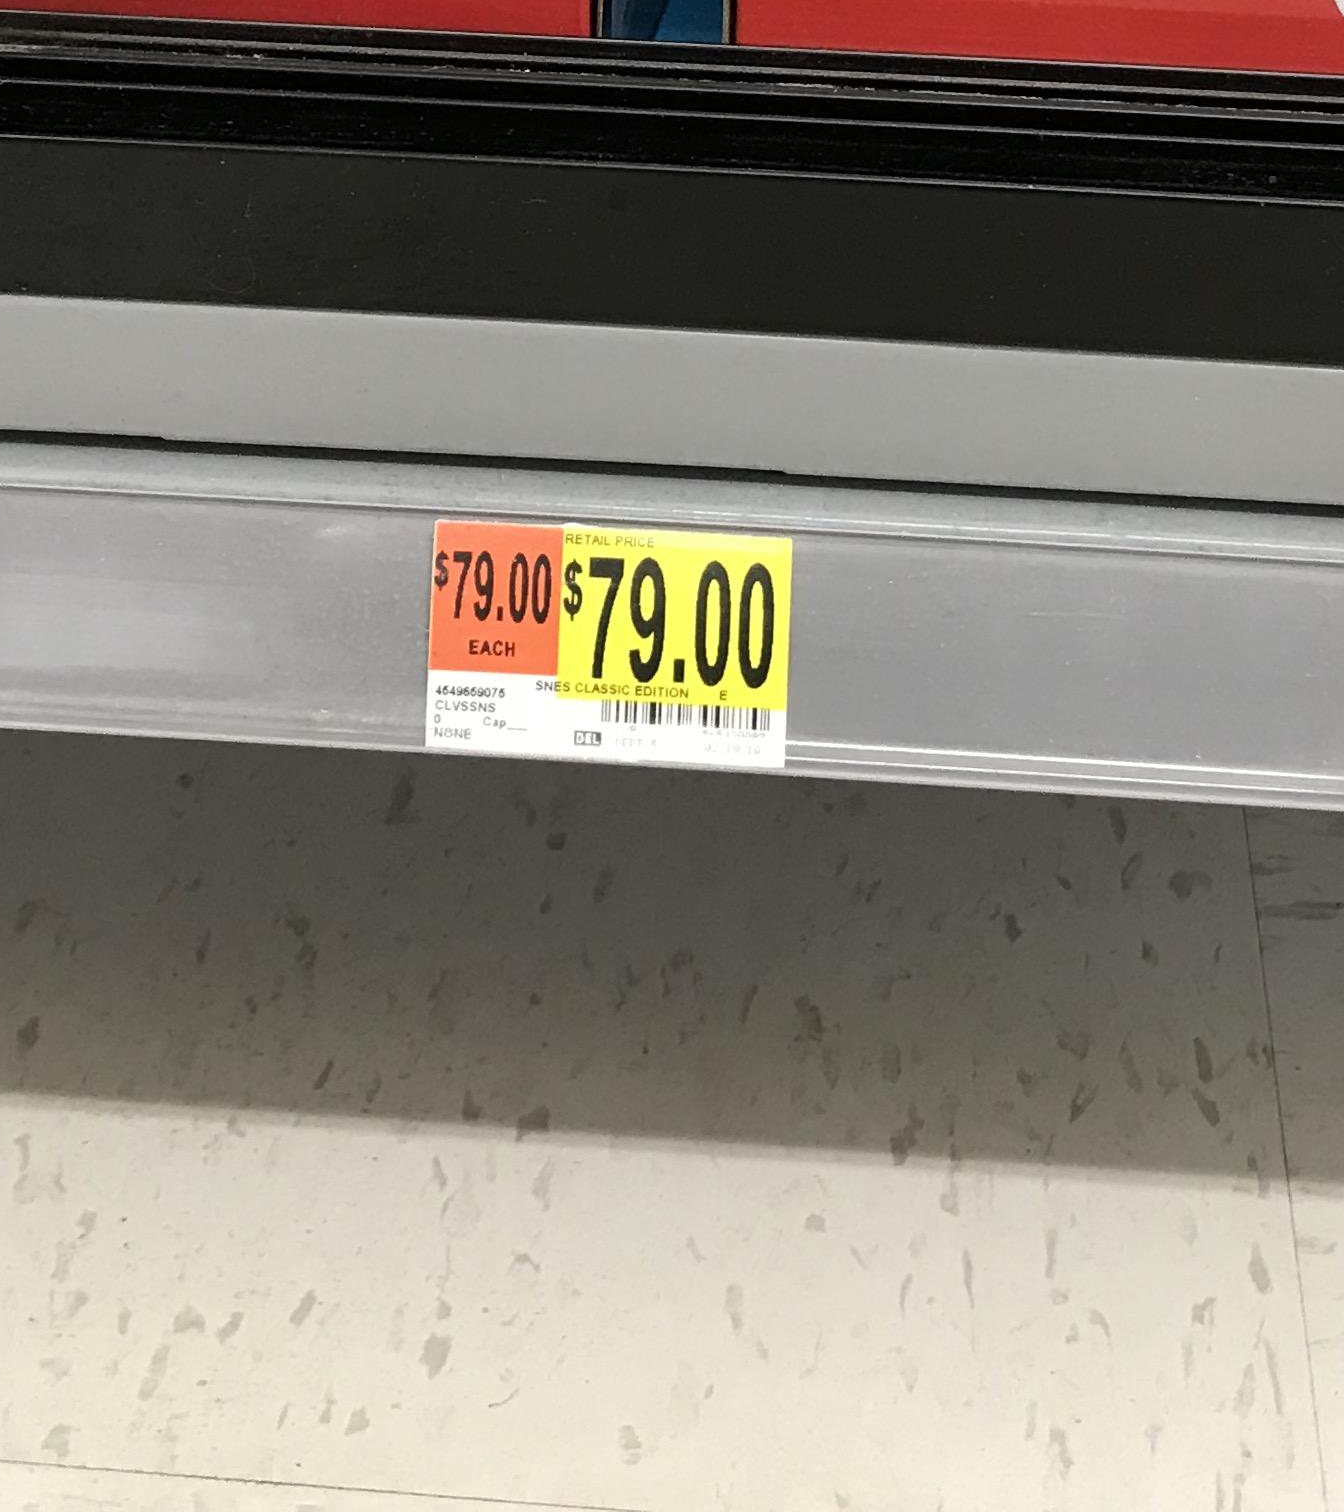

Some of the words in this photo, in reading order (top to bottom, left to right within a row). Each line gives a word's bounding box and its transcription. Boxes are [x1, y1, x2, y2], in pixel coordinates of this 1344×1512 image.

[565, 533, 610, 546] RETAIL
[615, 535, 655, 548] PRICE
[434, 550, 552, 624] $79.00
[563, 557, 775, 689] $79.00
[468, 639, 516, 658] EACH
[536, 680, 570, 692] SNES
[575, 681, 630, 696] CLASSIC
[635, 684, 689, 699] EDITION
[720, 690, 728, 701] E
[435, 700, 496, 713] CLVSSNS
[483, 716, 506, 729] Cap
[434, 727, 472, 740] NONE
